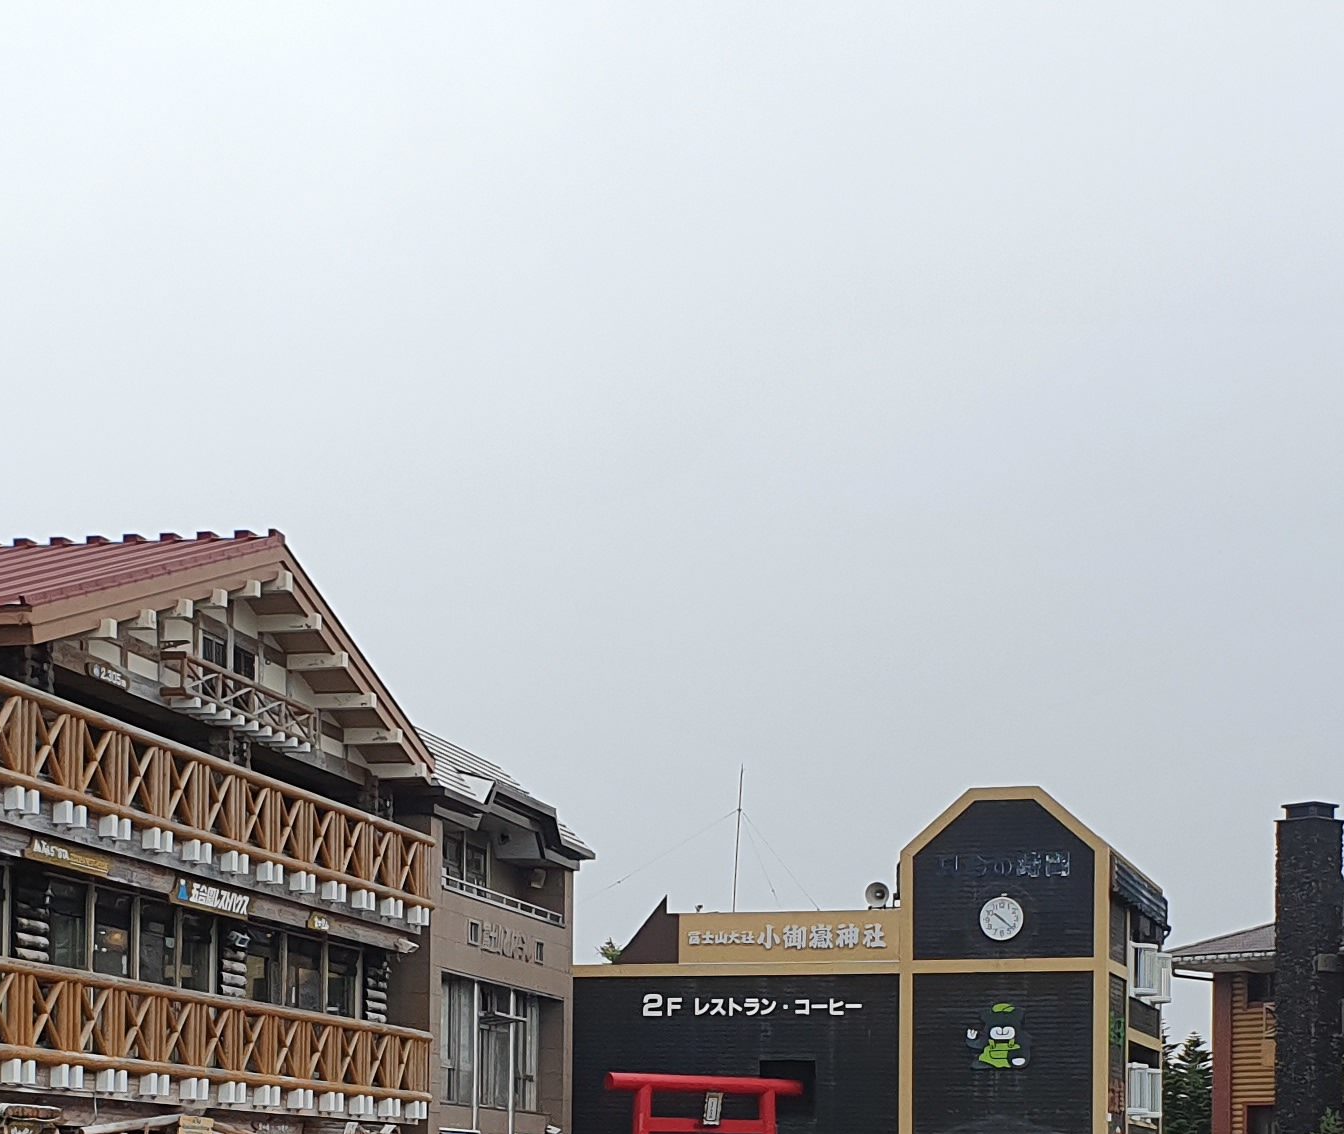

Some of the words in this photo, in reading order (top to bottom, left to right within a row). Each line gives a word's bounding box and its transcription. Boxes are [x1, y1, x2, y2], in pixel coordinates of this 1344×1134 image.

[642, 994, 682, 1017] 2F
[694, 997, 863, 1017] レストラン・コーヒー
